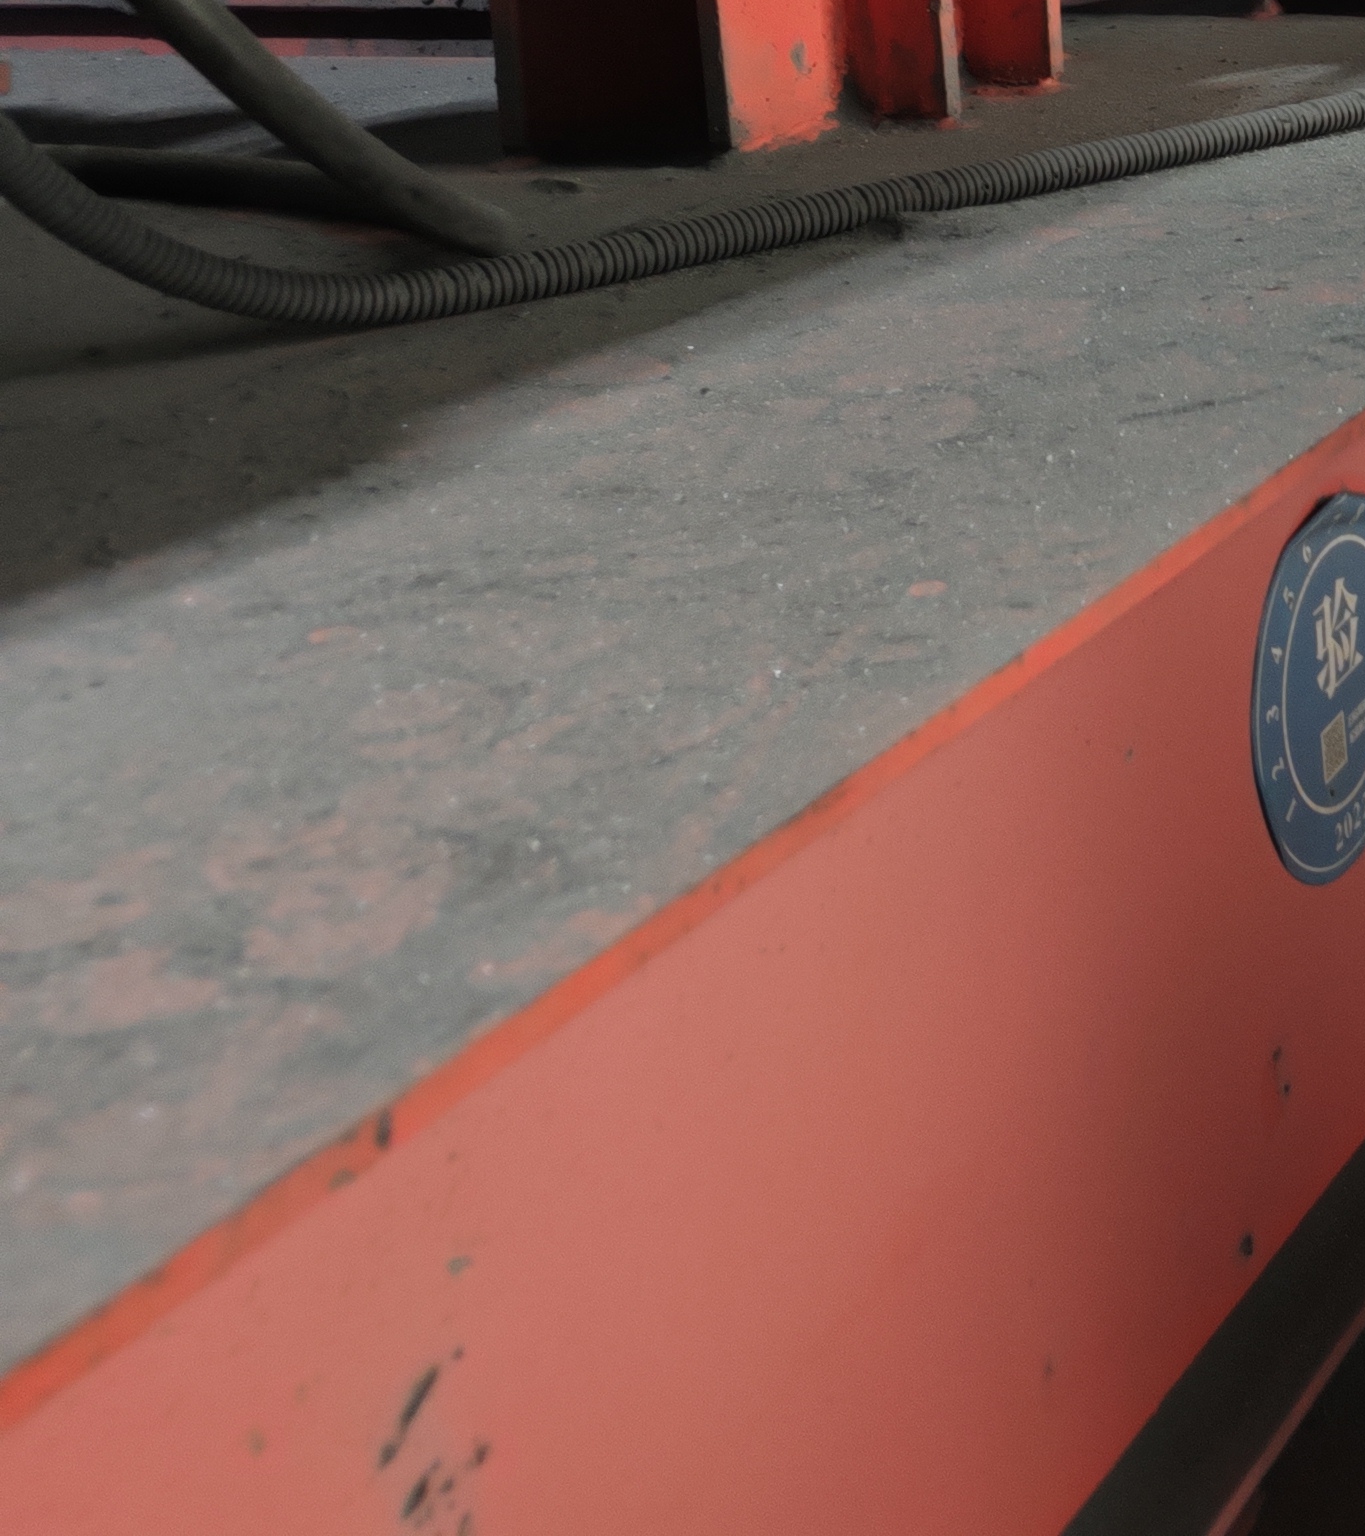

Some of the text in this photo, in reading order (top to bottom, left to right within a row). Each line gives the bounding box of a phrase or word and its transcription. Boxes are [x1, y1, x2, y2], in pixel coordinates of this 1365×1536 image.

[1312, 577, 1364, 700] 验
[1271, 646, 1283, 664] 4
[1266, 705, 1280, 724] 3
[1271, 756, 1285, 782] 2
[1285, 797, 1297, 823] 1
